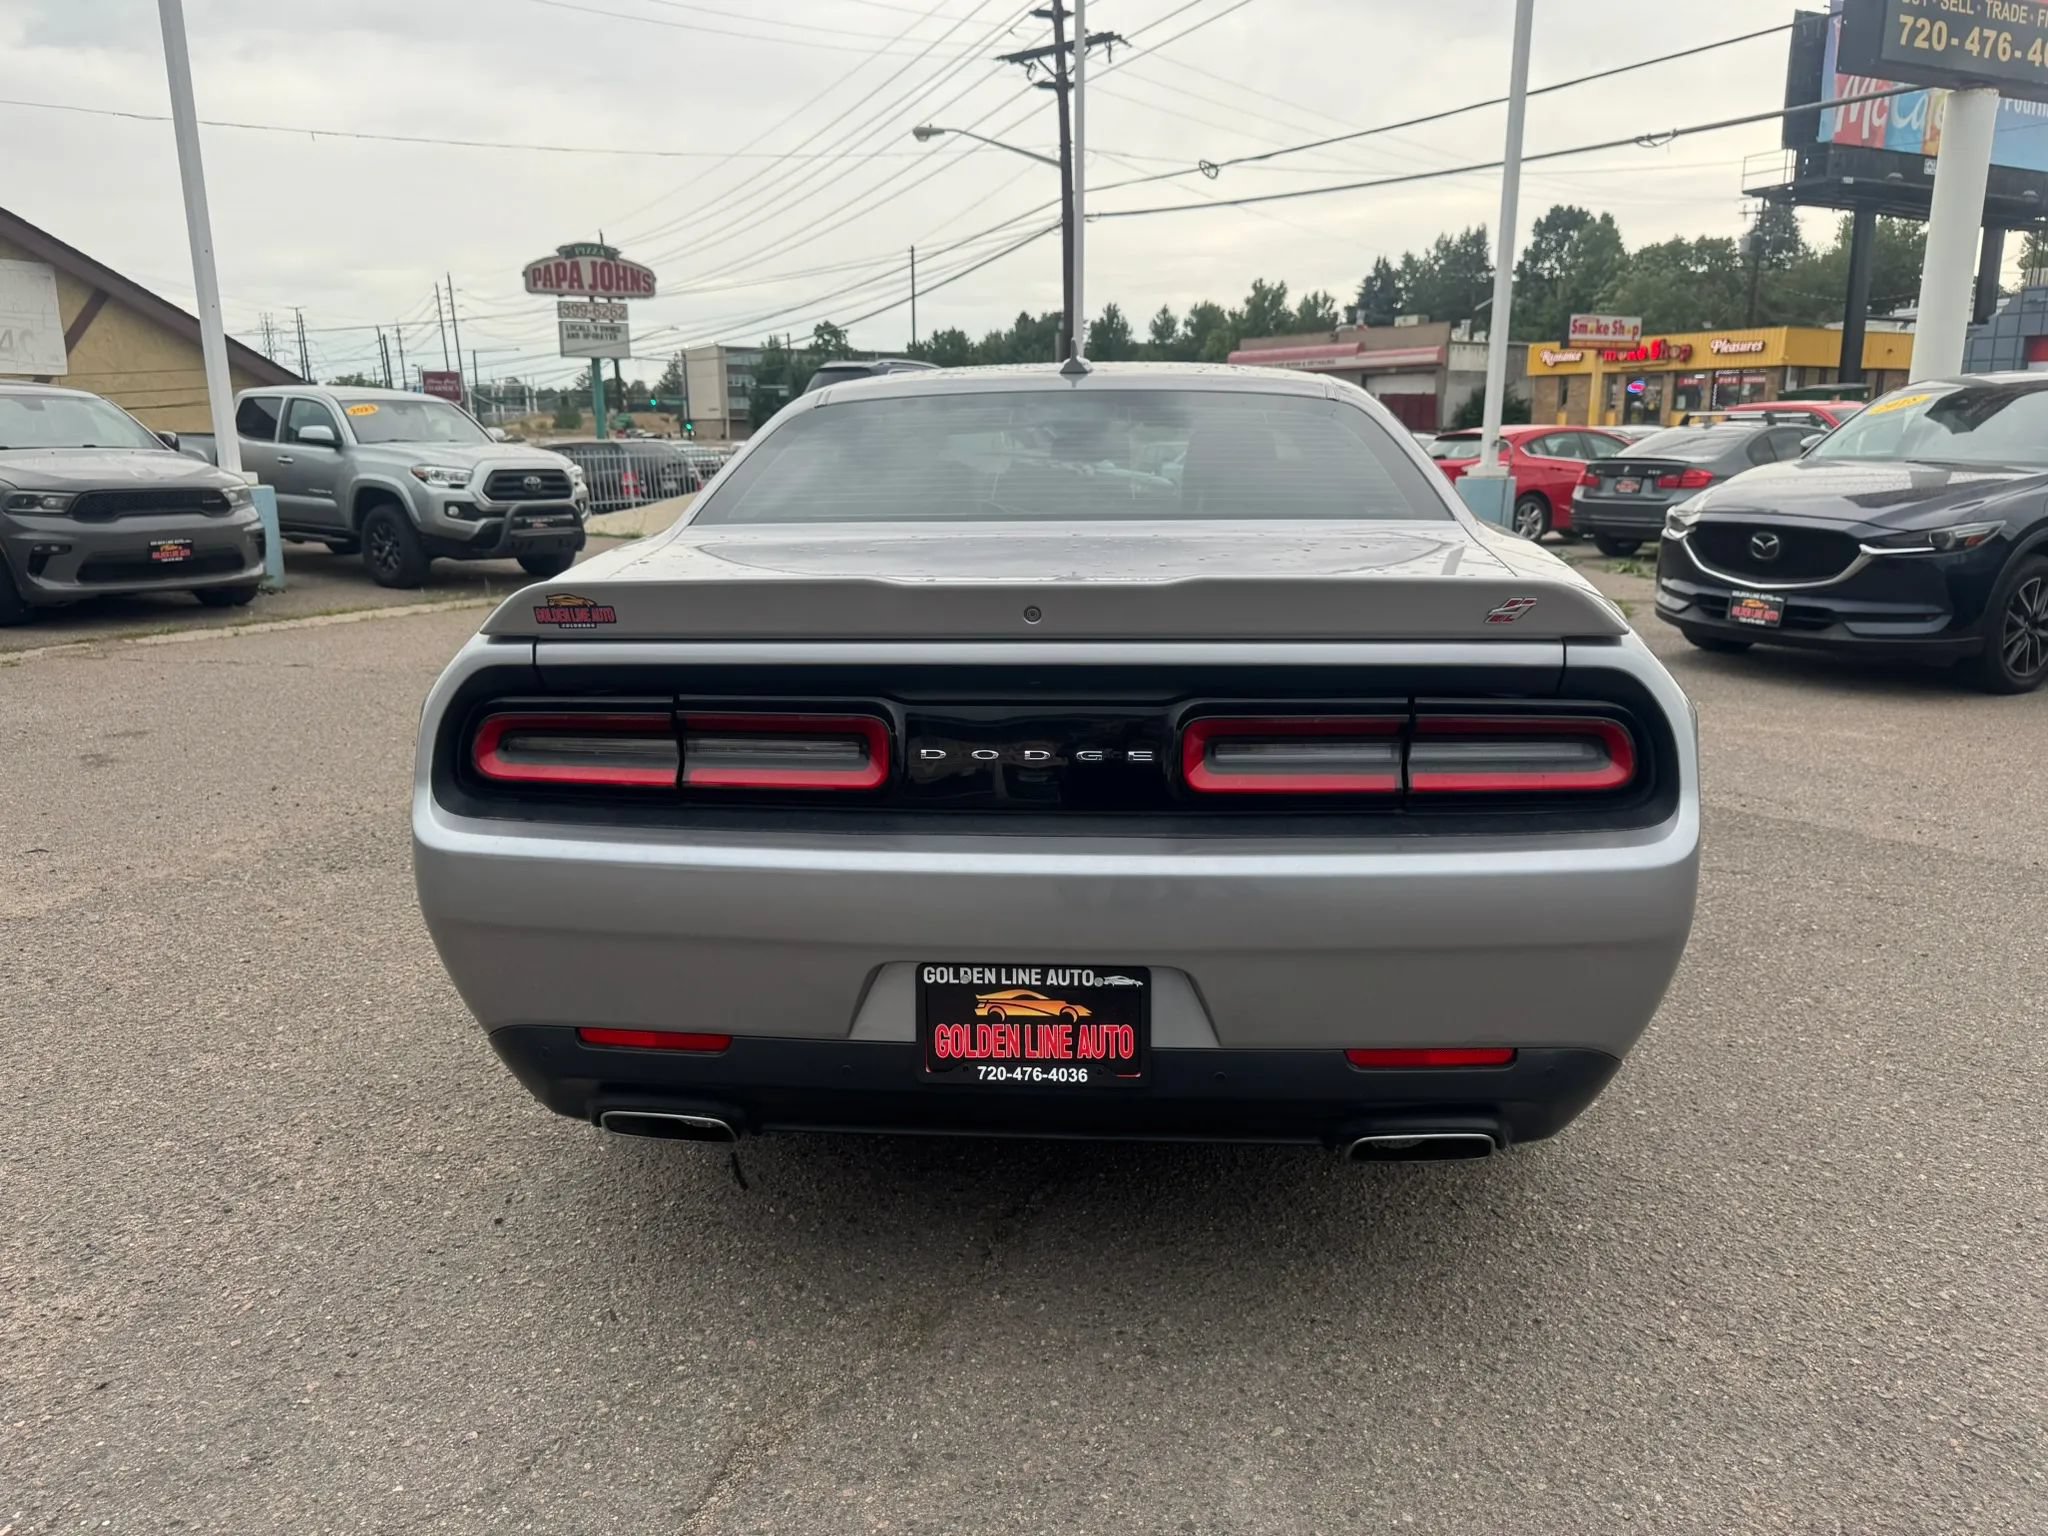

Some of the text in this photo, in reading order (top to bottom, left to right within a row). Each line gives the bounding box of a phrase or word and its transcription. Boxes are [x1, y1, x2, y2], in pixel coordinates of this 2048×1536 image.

[1986, 0, 2029, 24] TRADE
[1899, 14, 2048, 68] 720-476-4
[575, 246, 606, 256] PIZZA
[532, 260, 653, 293] PAPA JOHNS
[1710, 338, 1765, 354] Pleasures
[920, 749, 1154, 762] DODGE
[923, 966, 1095, 987] GOLDEN LINE AUTO
[935, 1023, 1135, 1060] GOLDEN LINE AUTO
[977, 1065, 1089, 1083] 720-476-4036
